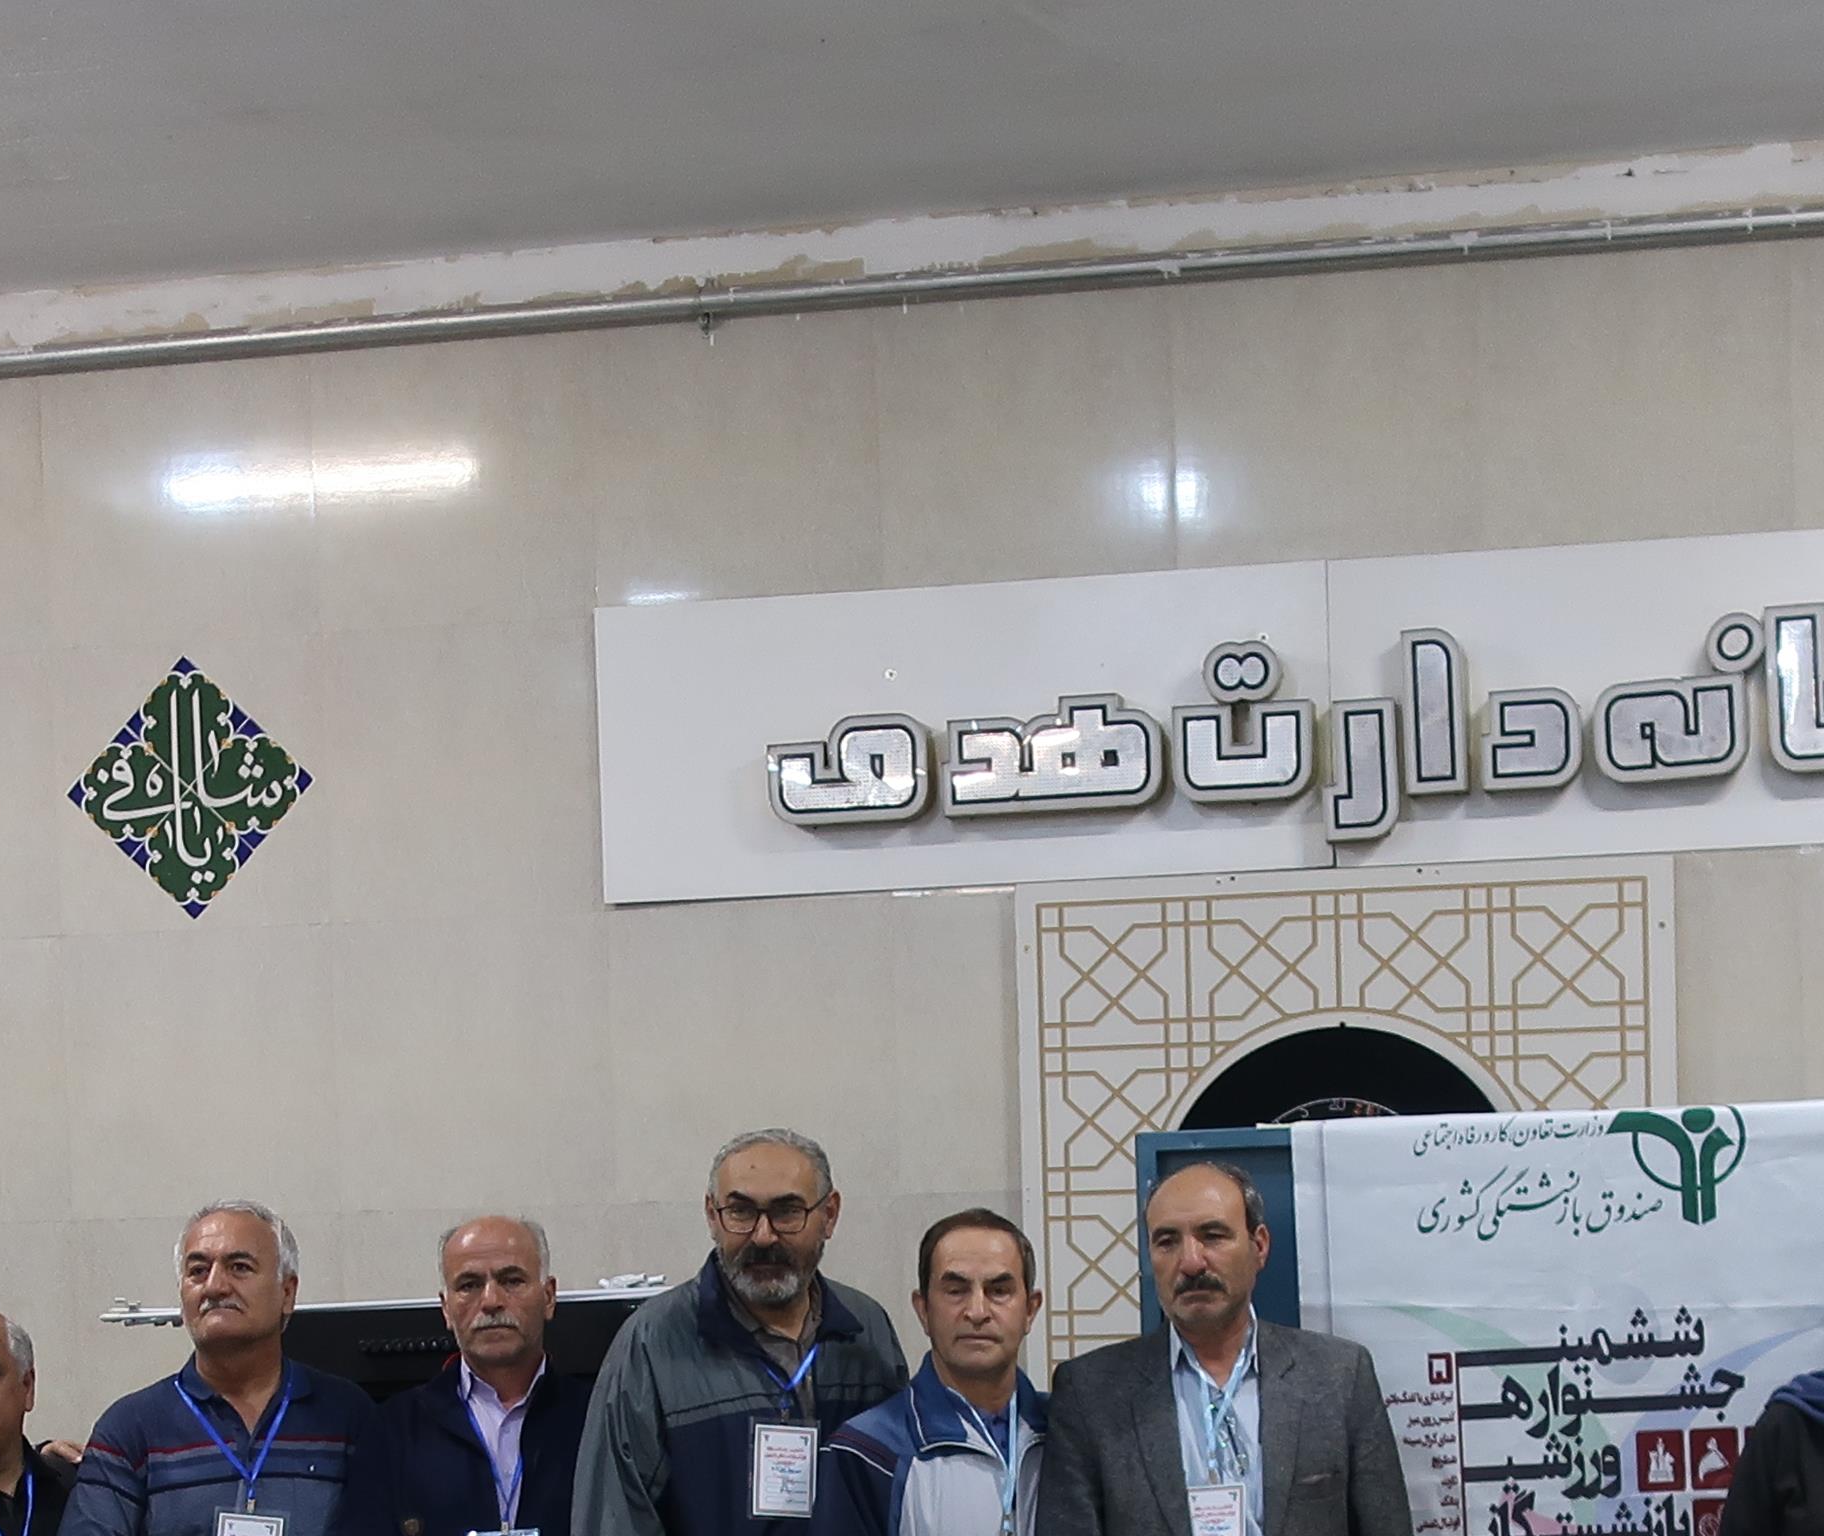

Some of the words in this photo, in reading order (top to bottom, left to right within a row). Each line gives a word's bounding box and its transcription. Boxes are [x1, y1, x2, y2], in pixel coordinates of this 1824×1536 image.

[1170, 627, 1583, 843] دارت
[1554, 1116, 1605, 1139] وزارت
[1416, 1165, 1509, 1234] کشوری
[1476, 1166, 1582, 1242] بازنشستگی
[1585, 1190, 1664, 1234] صندوق
[1459, 1362, 1746, 1439] جشنواره
[1462, 1432, 1622, 1500] ورزشی
